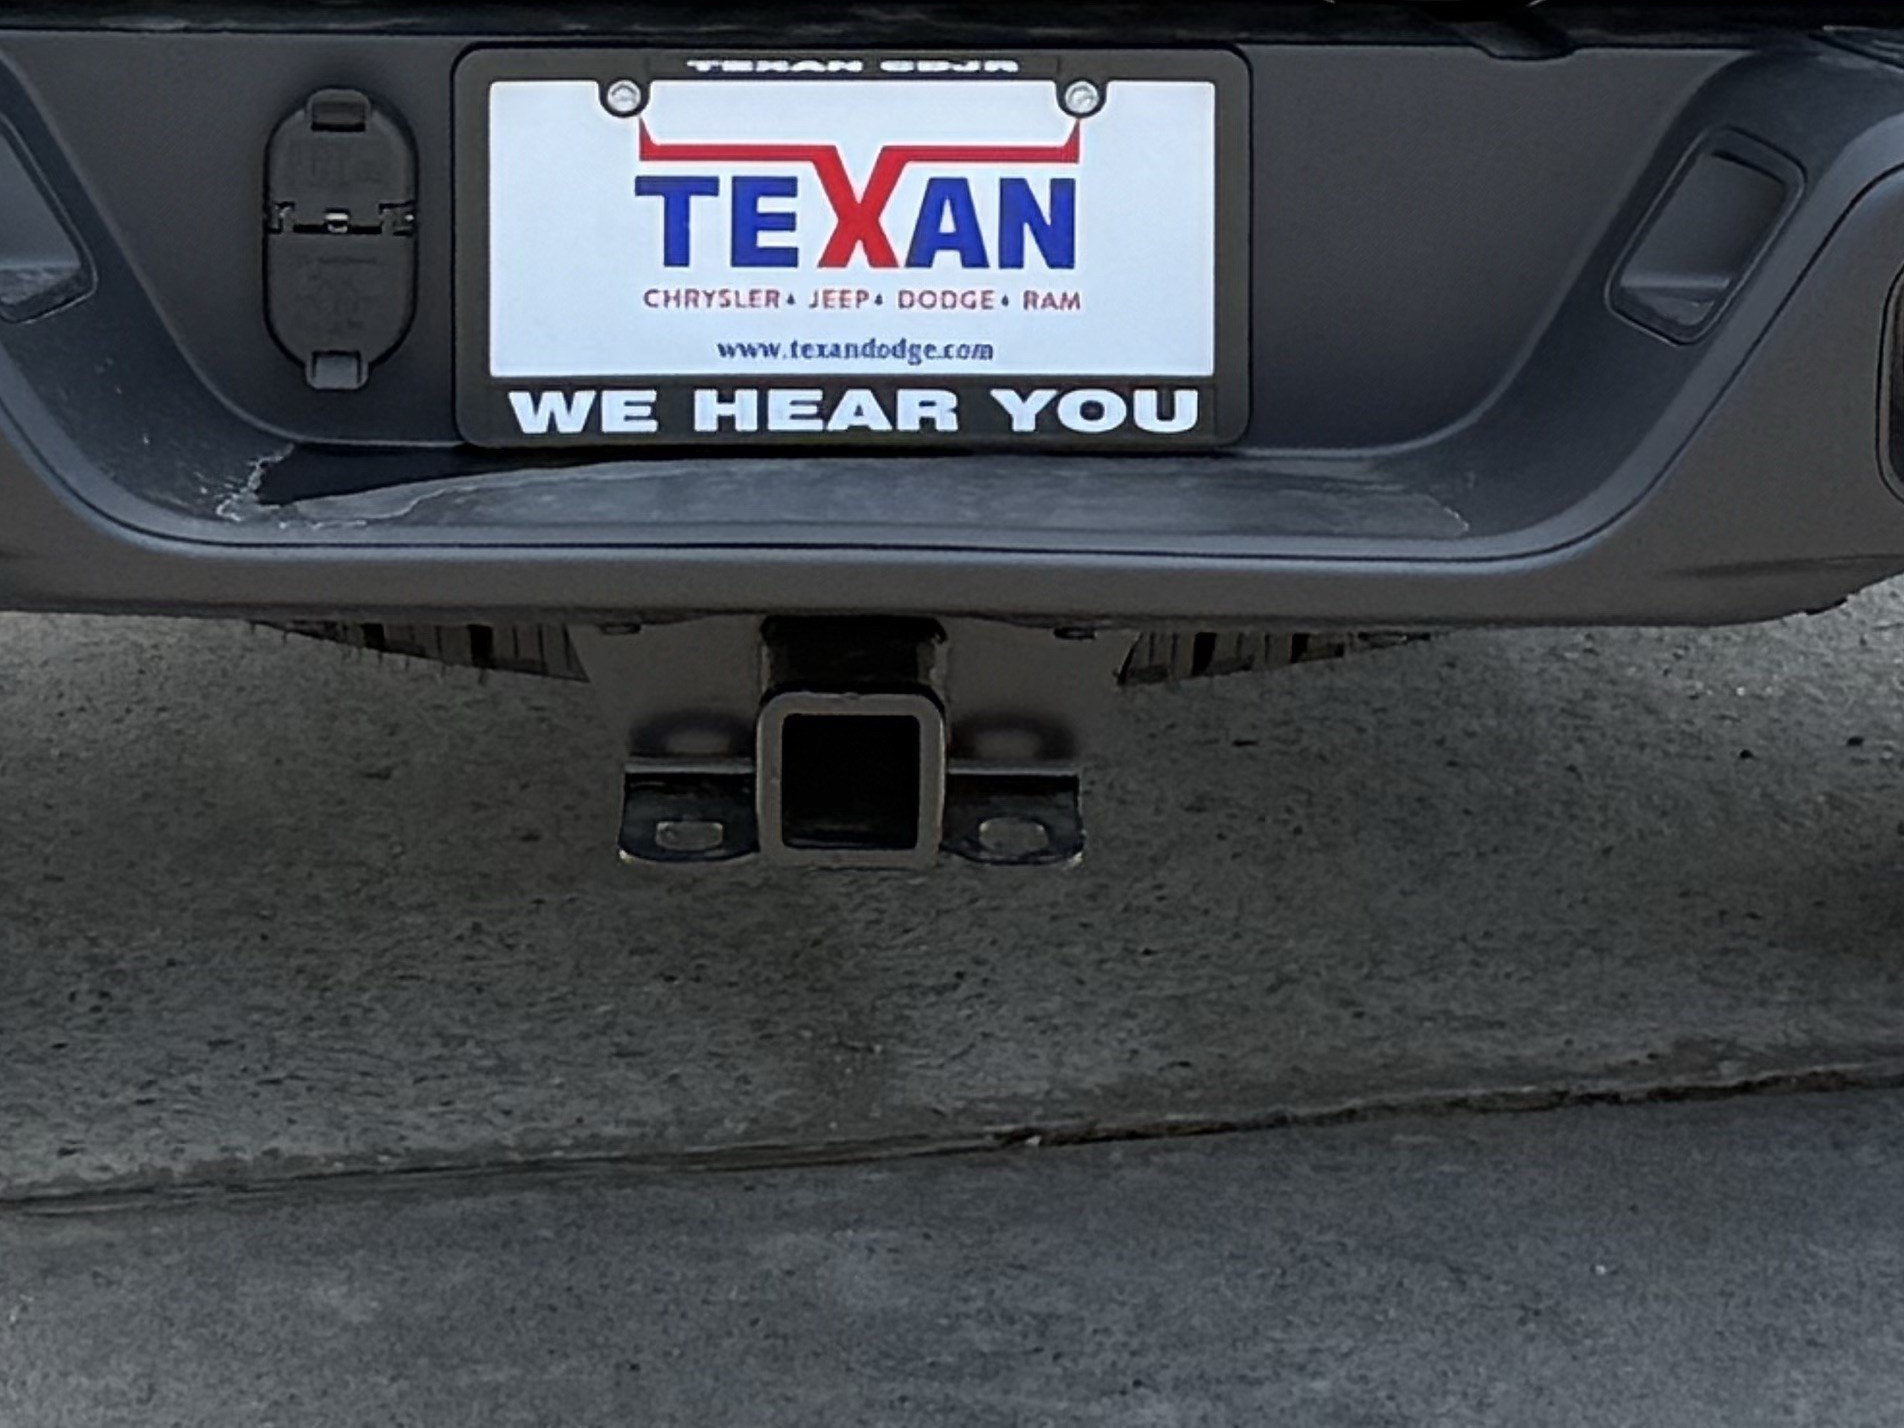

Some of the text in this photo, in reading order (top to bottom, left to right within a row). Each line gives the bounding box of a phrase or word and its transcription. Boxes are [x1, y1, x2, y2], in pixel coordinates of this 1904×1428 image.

[634, 145, 1077, 270] TEXAN
[642, 287, 1082, 312] CHRYSLER JEEP DODGE RAM
[716, 337, 994, 366] www.texandodge.com
[508, 389, 1200, 435] WE HEAR YOU
